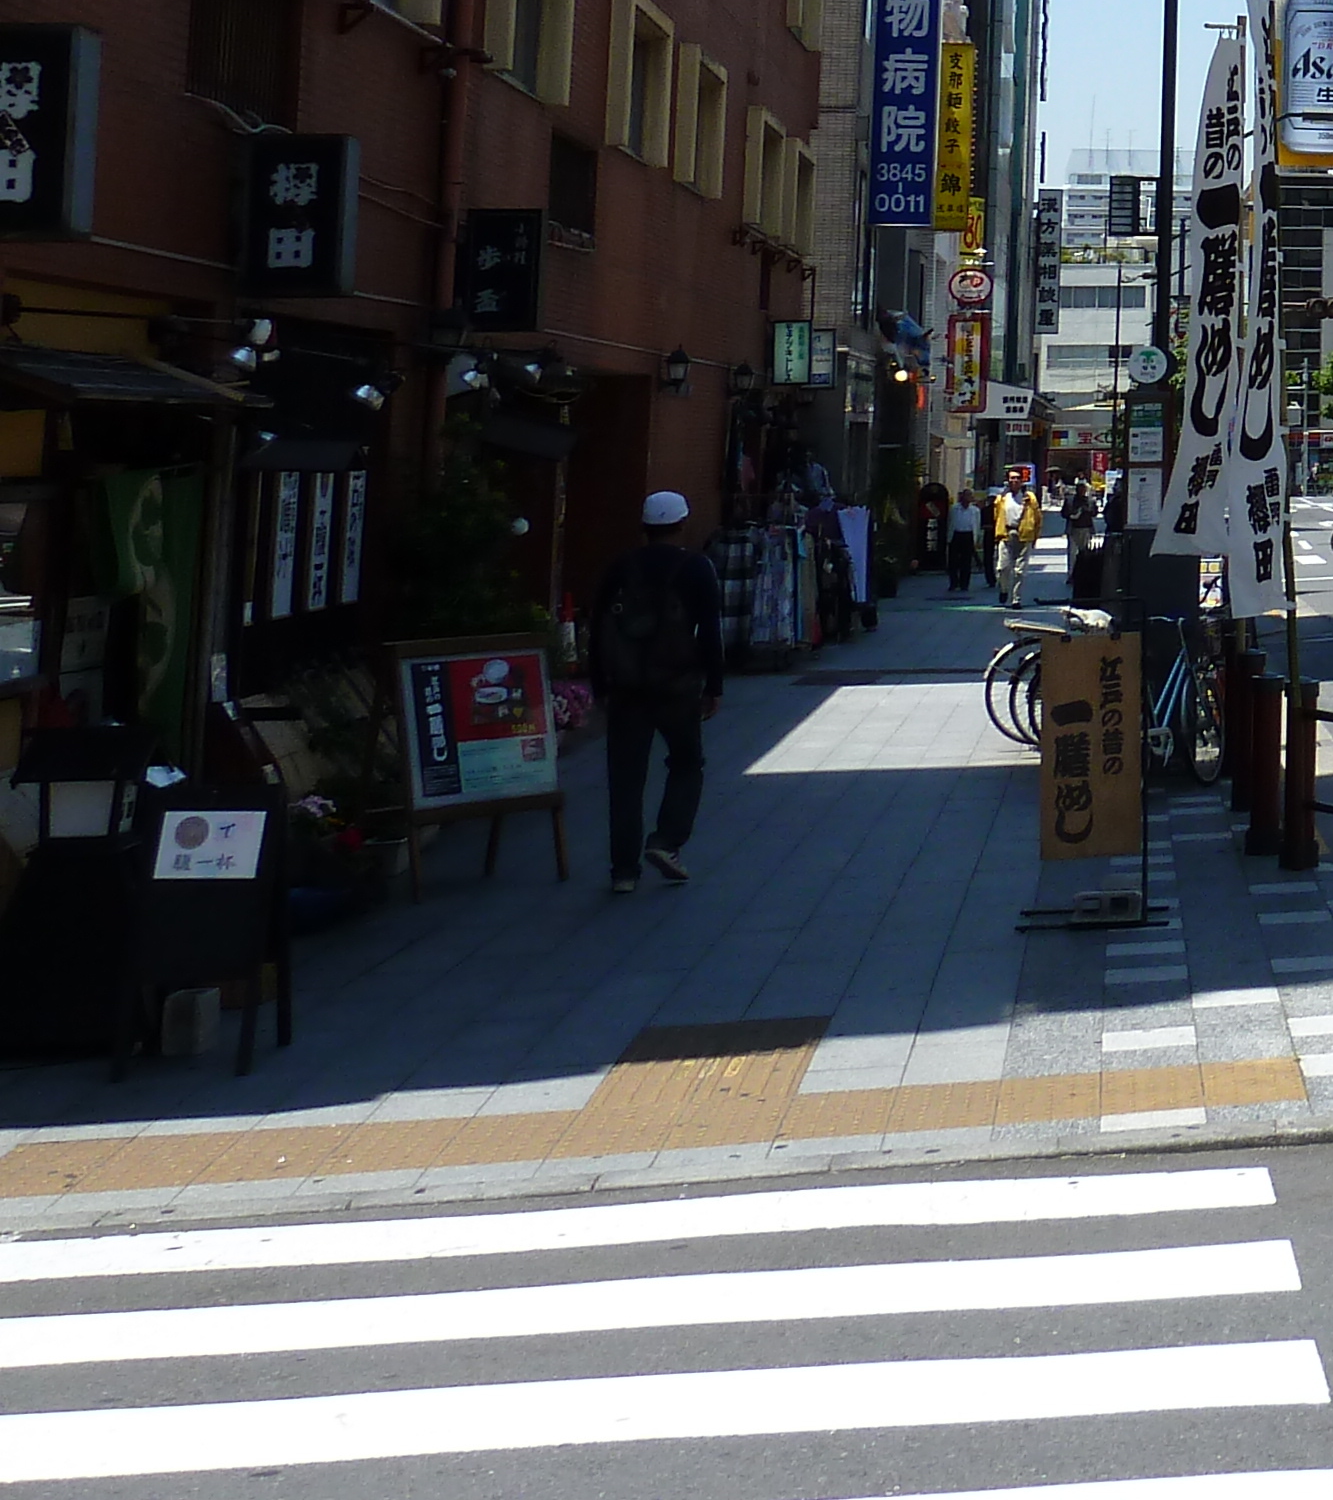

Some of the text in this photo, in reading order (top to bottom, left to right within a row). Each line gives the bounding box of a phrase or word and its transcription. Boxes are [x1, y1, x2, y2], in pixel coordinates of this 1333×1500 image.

[876, 163, 926, 182] 3845
[1203, 106, 1225, 179] 昔の
[874, 193, 925, 213] 0011
[1100, 655, 1124, 775] 江戸の昔の
[1050, 699, 1094, 845] 一膳めし
